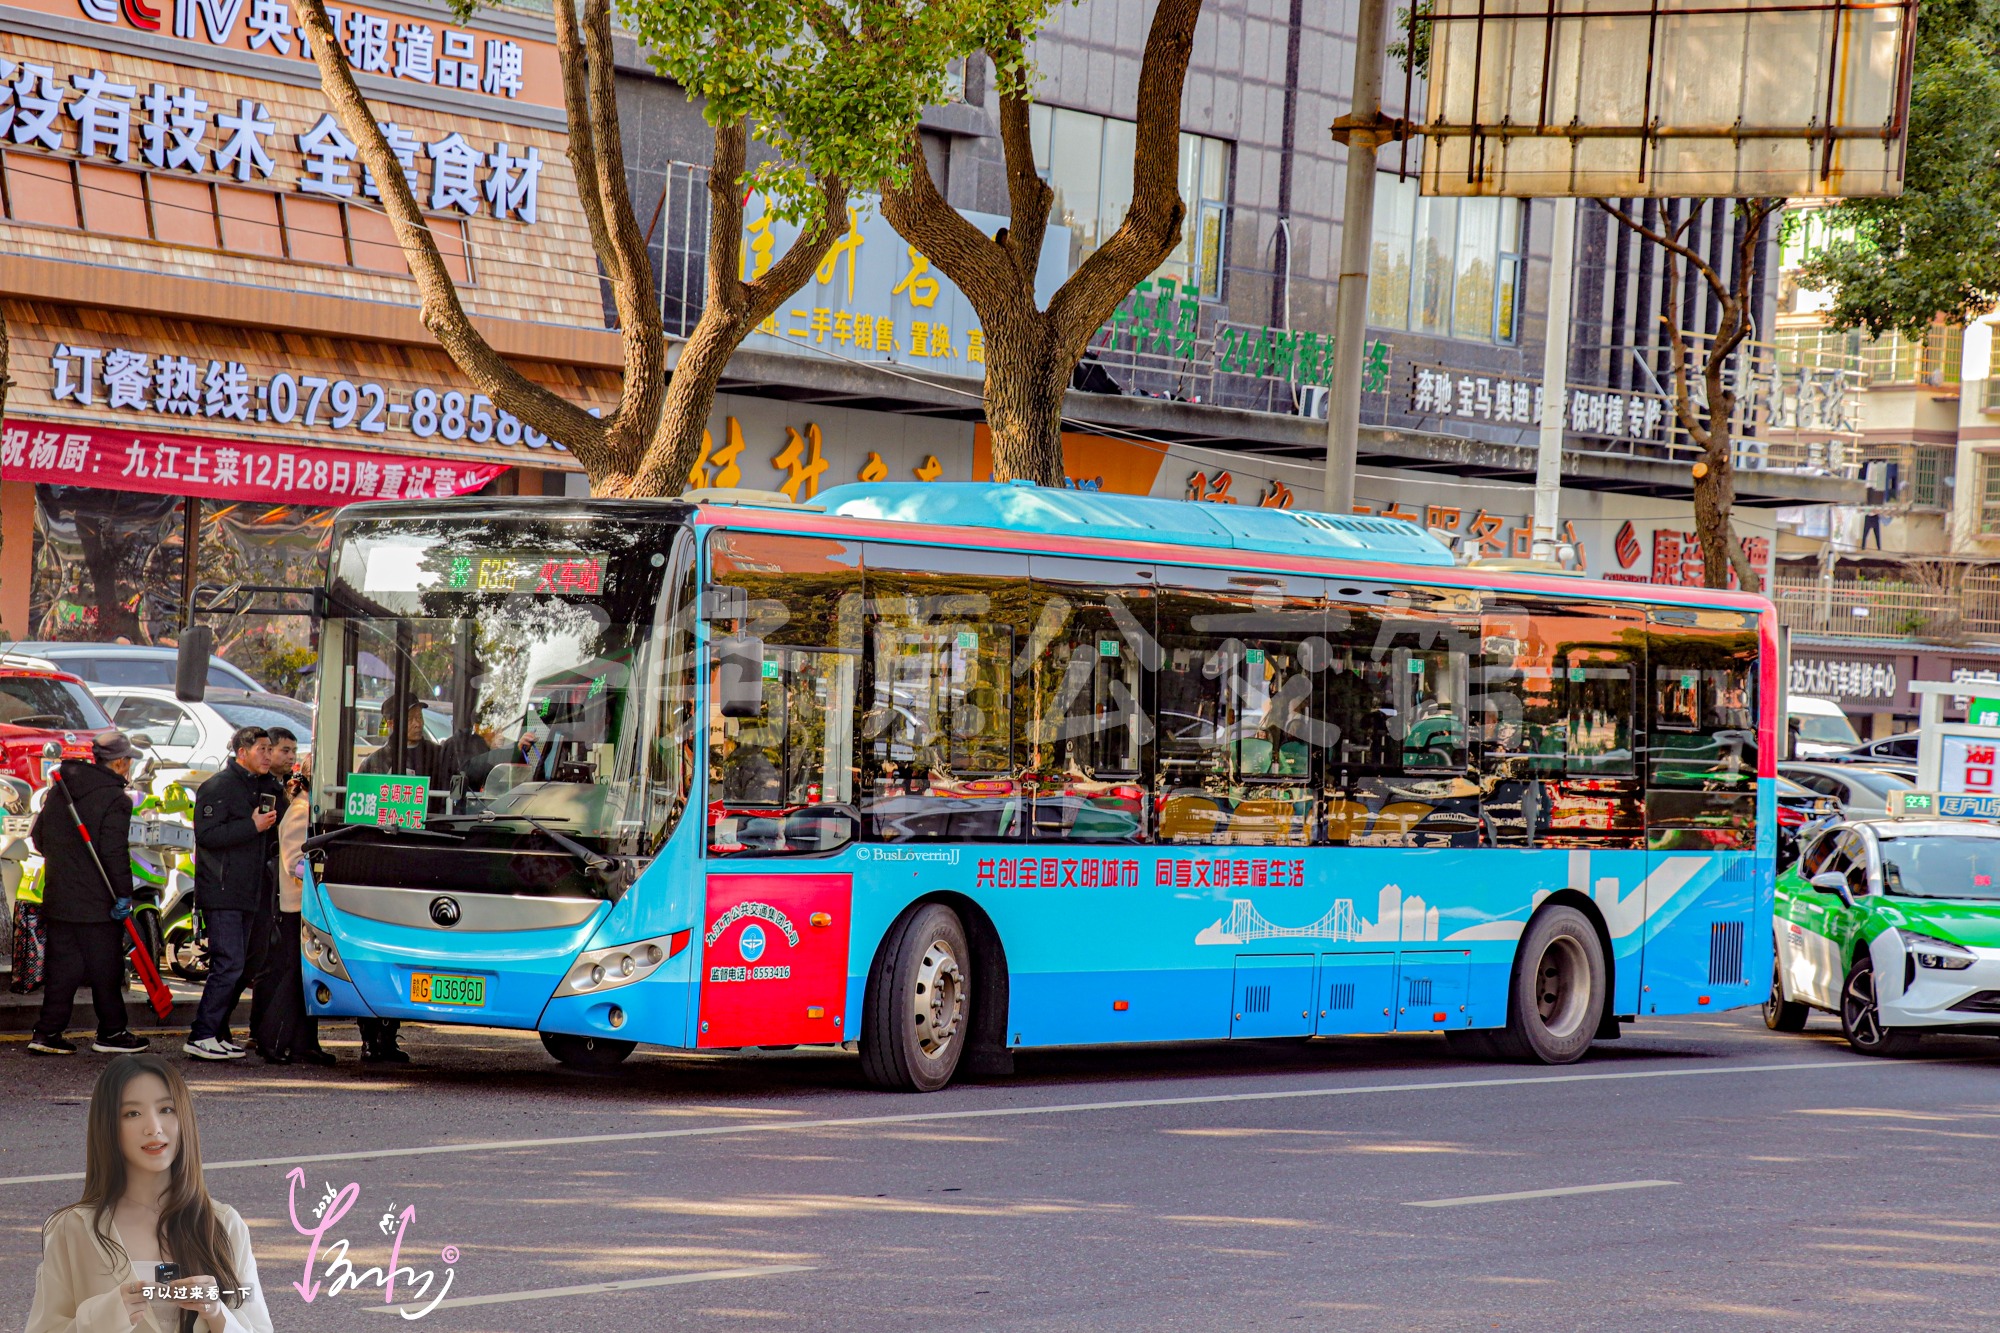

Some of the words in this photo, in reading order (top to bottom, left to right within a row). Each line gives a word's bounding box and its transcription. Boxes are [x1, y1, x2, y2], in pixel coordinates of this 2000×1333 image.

[1220, 325, 1389, 393] 24小时救务
[1414, 368, 1452, 413] 奔驰
[1456, 375, 1493, 420] 宝马
[1495, 380, 1531, 424] 奥迪
[1571, 390, 1624, 436] 保时捷
[536, 557, 603, 593] 火车站
[1965, 744, 1996, 793] 湖口
[348, 792, 377, 816] 63路
[379, 782, 425, 805] 空调开启
[1904, 794, 1931, 808] 空车
[377, 807, 422, 829] 票价+1元
[976, 857, 1140, 888] 共创全国文明城市
[1155, 858, 1305, 888] 同享文明幸福生活
[705, 902, 800, 948] 九江市公共交通集团公司
[710, 965, 791, 982] 监督电话:8553416
